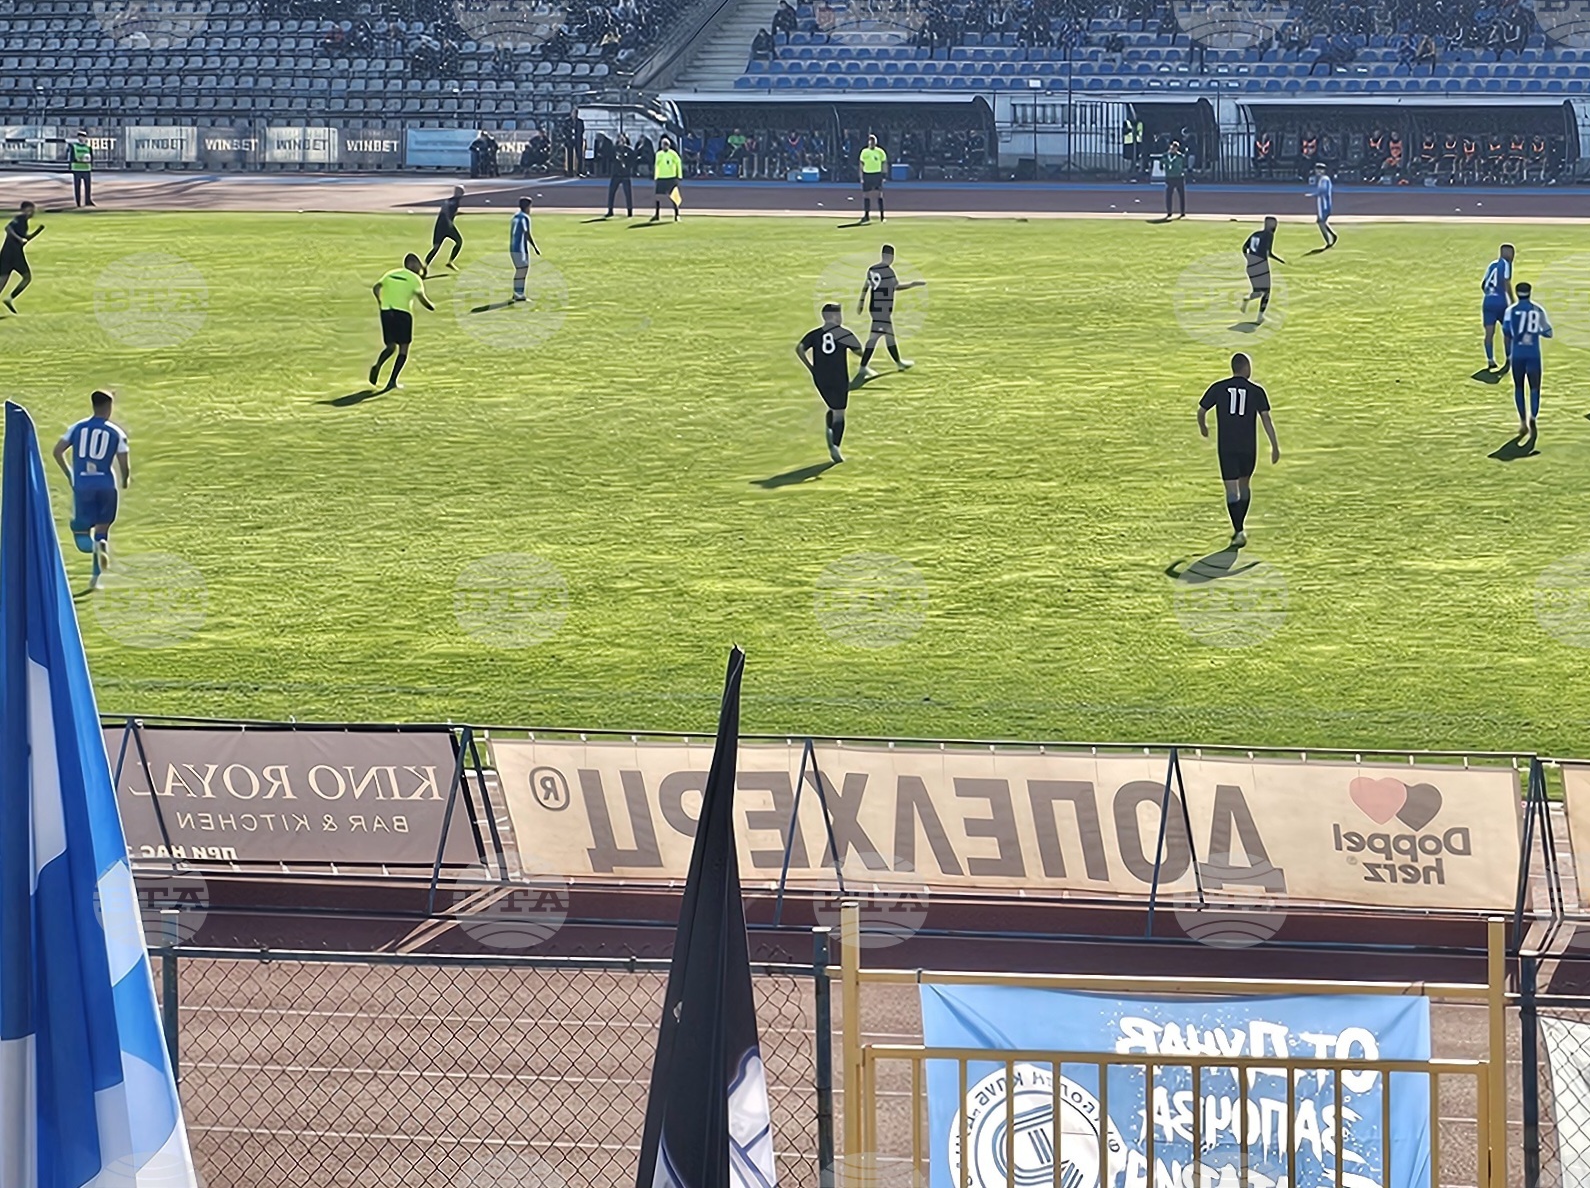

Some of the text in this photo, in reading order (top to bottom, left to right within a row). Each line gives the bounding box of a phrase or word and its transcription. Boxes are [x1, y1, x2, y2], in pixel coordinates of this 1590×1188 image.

[204, 138, 259, 151] WINBET
[346, 139, 400, 152] WINBET
[1514, 310, 1540, 334] 78
[821, 332, 836, 355] 8
[1227, 387, 1247, 416] 11
[79, 427, 110, 460] 10
